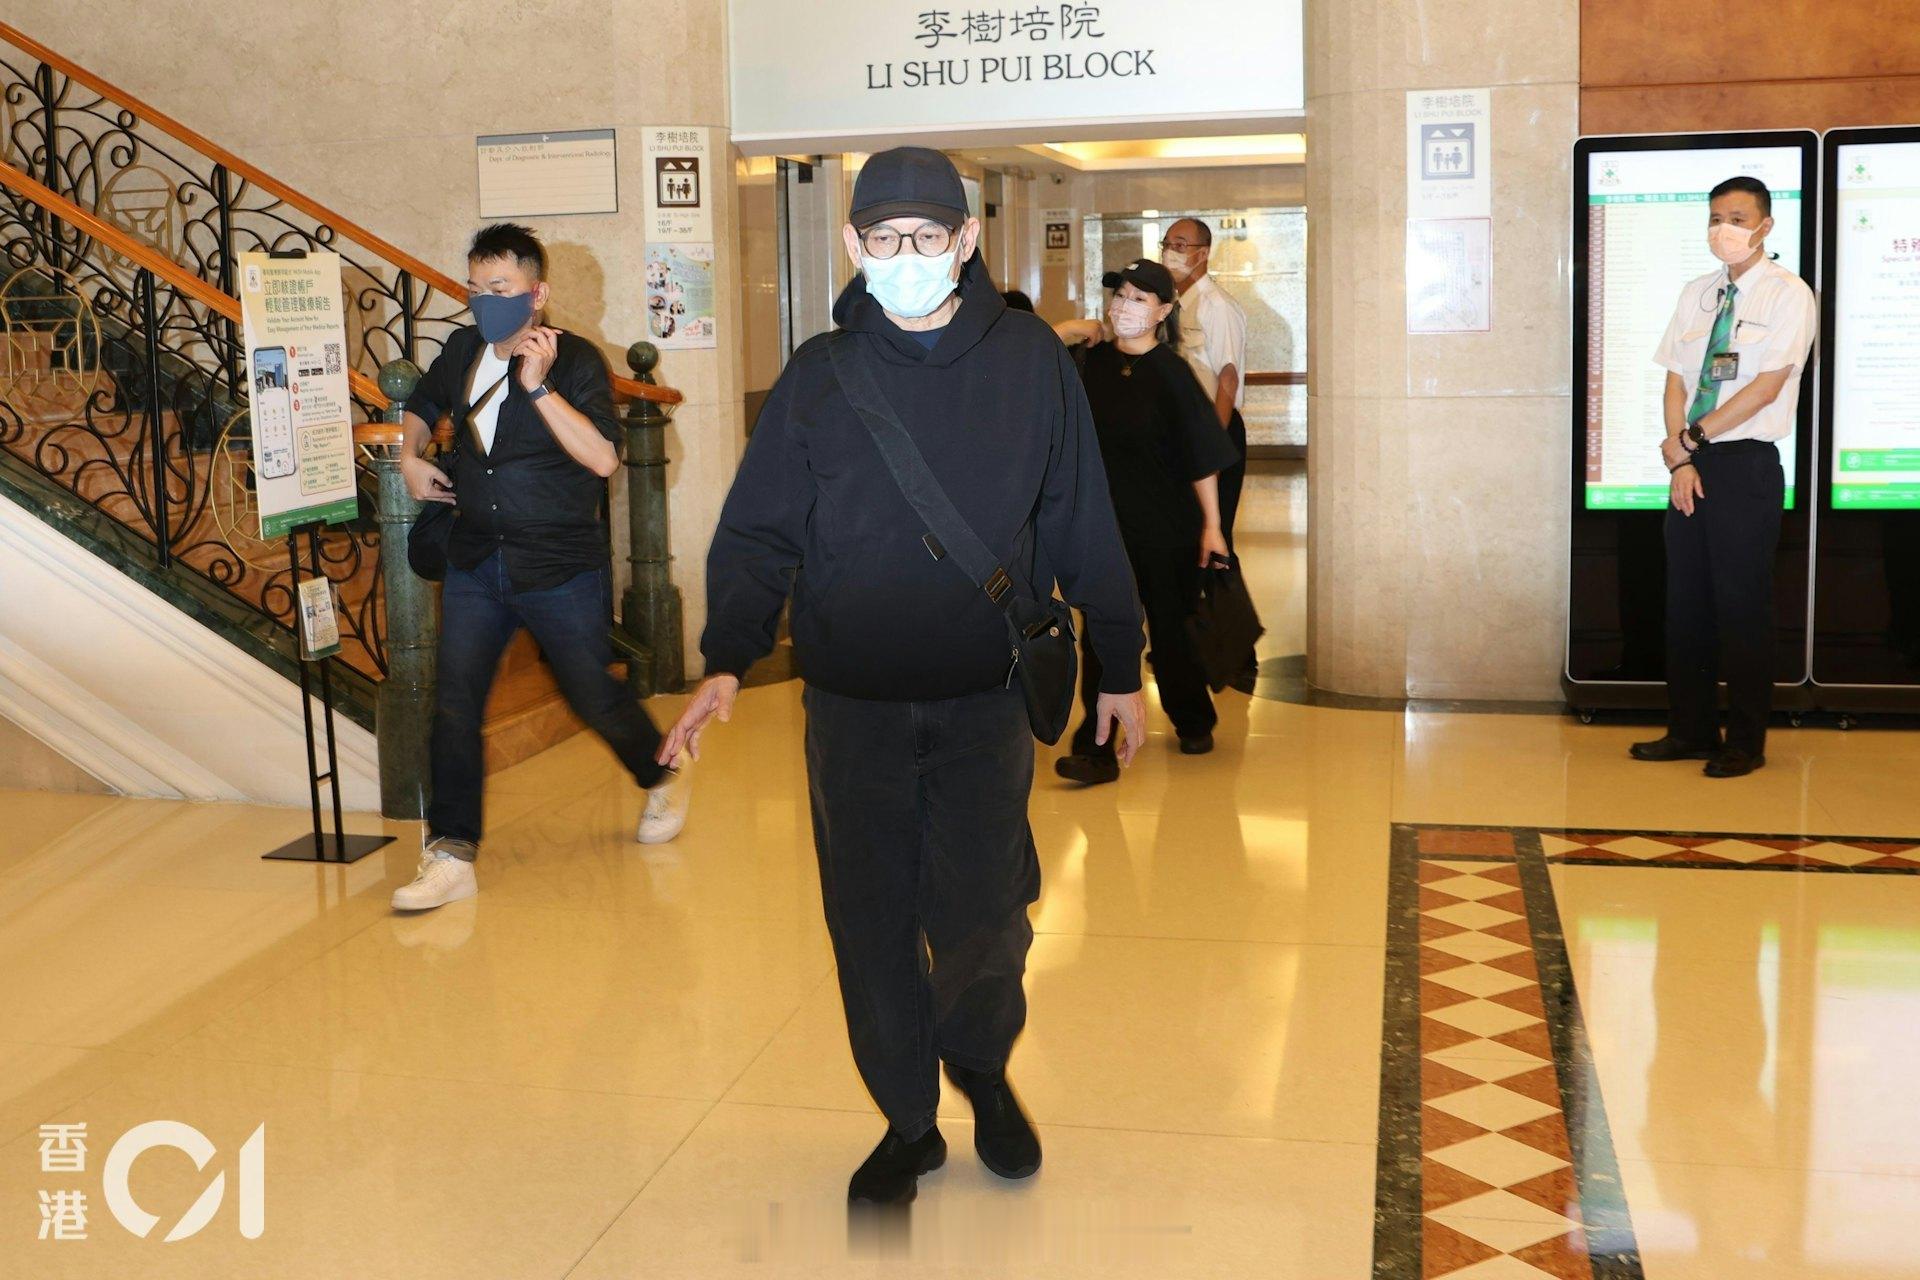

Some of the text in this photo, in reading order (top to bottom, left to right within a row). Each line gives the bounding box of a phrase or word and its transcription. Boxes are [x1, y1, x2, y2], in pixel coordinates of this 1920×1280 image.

[915, 1, 1105, 49] 李樹培院
[867, 50, 1157, 89] LI SHU PUI BLOCK
[656, 131, 699, 143] 李樹培院
